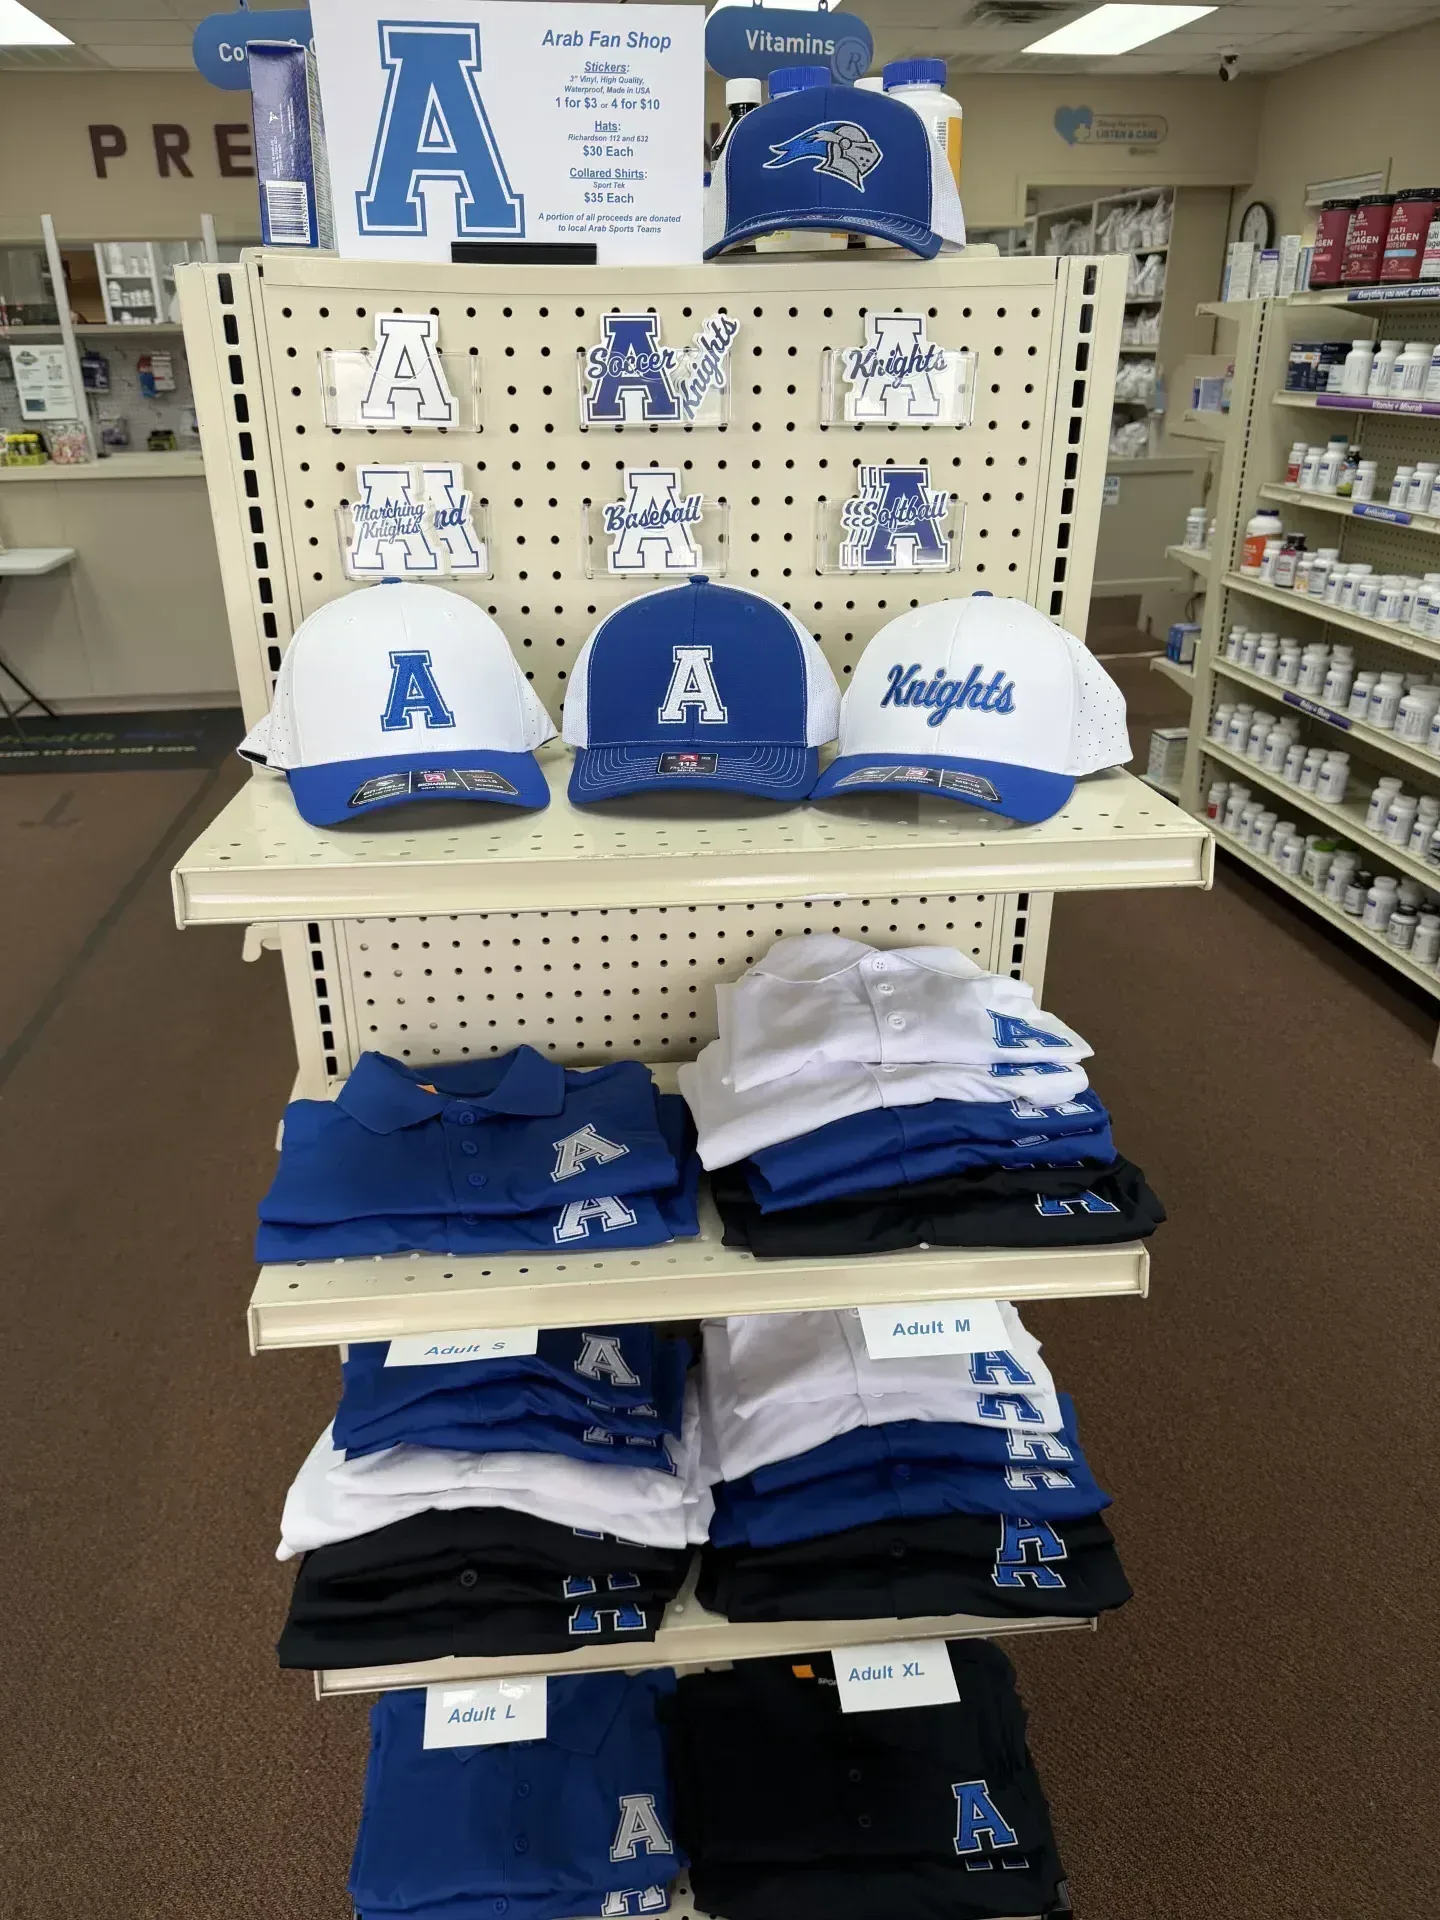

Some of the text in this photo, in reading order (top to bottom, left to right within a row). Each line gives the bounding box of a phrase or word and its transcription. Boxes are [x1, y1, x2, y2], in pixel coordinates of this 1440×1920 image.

[218, 42, 247, 62] Co
[542, 29, 671, 52] Arab Fan Shop
[745, 29, 835, 55] Vitamins
[580, 76, 599, 85] Vinyl,
[601, 76, 616, 85] High
[618, 77, 645, 85] Quality,
[584, 61, 629, 73] Stickers:
[556, 97, 561, 107] 1
[565, 97, 581, 108] for
[584, 97, 597, 109] $3
[611, 99, 617, 108] 4
[621, 99, 637, 109] for
[641, 99, 660, 110] $10
[564, 86, 604, 94] Waterproof,
[606, 86, 625, 94] Made
[355, 20, 526, 238] A
[568, 134, 607, 142] Richardson
[595, 121, 621, 132] Hats:
[583, 145, 633, 157] $30 Each
[569, 168, 647, 180] Collared Shirts:
[593, 181, 612, 189] Sport
[584, 192, 634, 204] $35 Each
[546, 213, 574, 222] portion
[576, 213, 584, 221] of
[597, 214, 632, 223] proceeds
[568, 224, 586, 232] local
[609, 225, 634, 234] Sports
[637, 225, 661, 233] Teams
[1358, 289, 1383, 300] Everything
[1384, 290, 1395, 300] you
[361, 318, 452, 421] A
[587, 316, 681, 421] A
[588, 348, 677, 379] Soccer
[681, 316, 738, 420] Knights
[850, 343, 948, 389] Knights
[854, 317, 940, 417] A
[352, 470, 438, 570] A
[354, 499, 426, 523] Marching
[434, 494, 467, 530] nd
[604, 494, 703, 532] Baseball
[613, 473, 697, 569] A
[861, 493, 947, 532] Softball
[861, 467, 948, 566] A
[362, 517, 422, 545] Knights
[380, 649, 456, 732] A
[658, 645, 728, 725] A
[880, 663, 1016, 727] Knights
[986, 1009, 1073, 1048] A
[550, 1123, 630, 1183] A
[553, 1195, 638, 1244] A
[892, 1318, 971, 1337] Adult M
[424, 1341, 506, 1356] Adult S
[574, 1332, 640, 1386] A
[996, 1513, 1068, 1564] A
[848, 1661, 925, 1682] Adult XL
[448, 1704, 516, 1724] Adult L
[609, 1793, 674, 1862] A
[951, 1779, 1018, 1855] A
